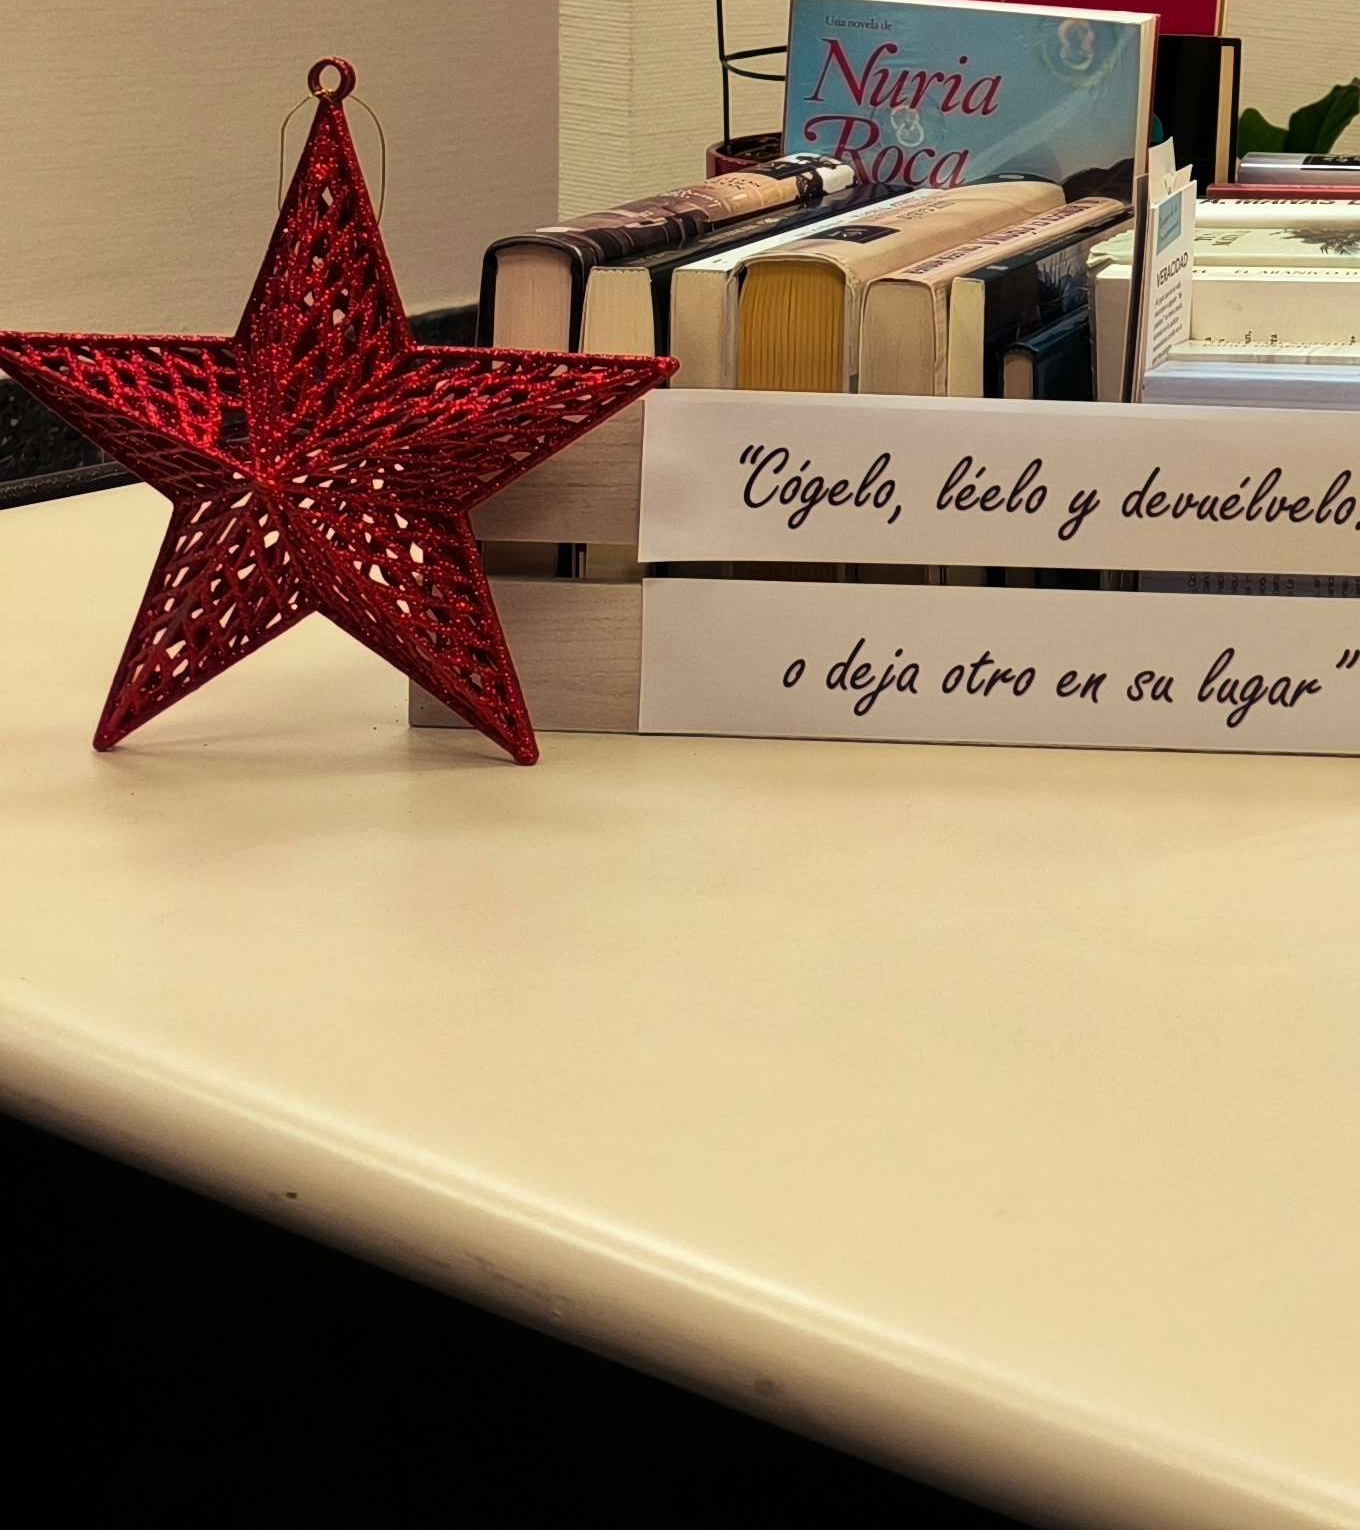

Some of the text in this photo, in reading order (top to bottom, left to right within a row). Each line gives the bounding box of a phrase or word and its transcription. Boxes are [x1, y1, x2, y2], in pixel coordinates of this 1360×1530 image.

[847, 18, 879, 30] novela
[804, 38, 1002, 115] Nuria
[804, 115, 970, 189] Roca
[1156, 251, 1189, 289] VERACIDAD
[739, 443, 904, 529] “Cógelo,
[935, 457, 1048, 516] léelo
[1058, 488, 1101, 540] y
[782, 637, 1360, 729] o deja otro en su lugar”
